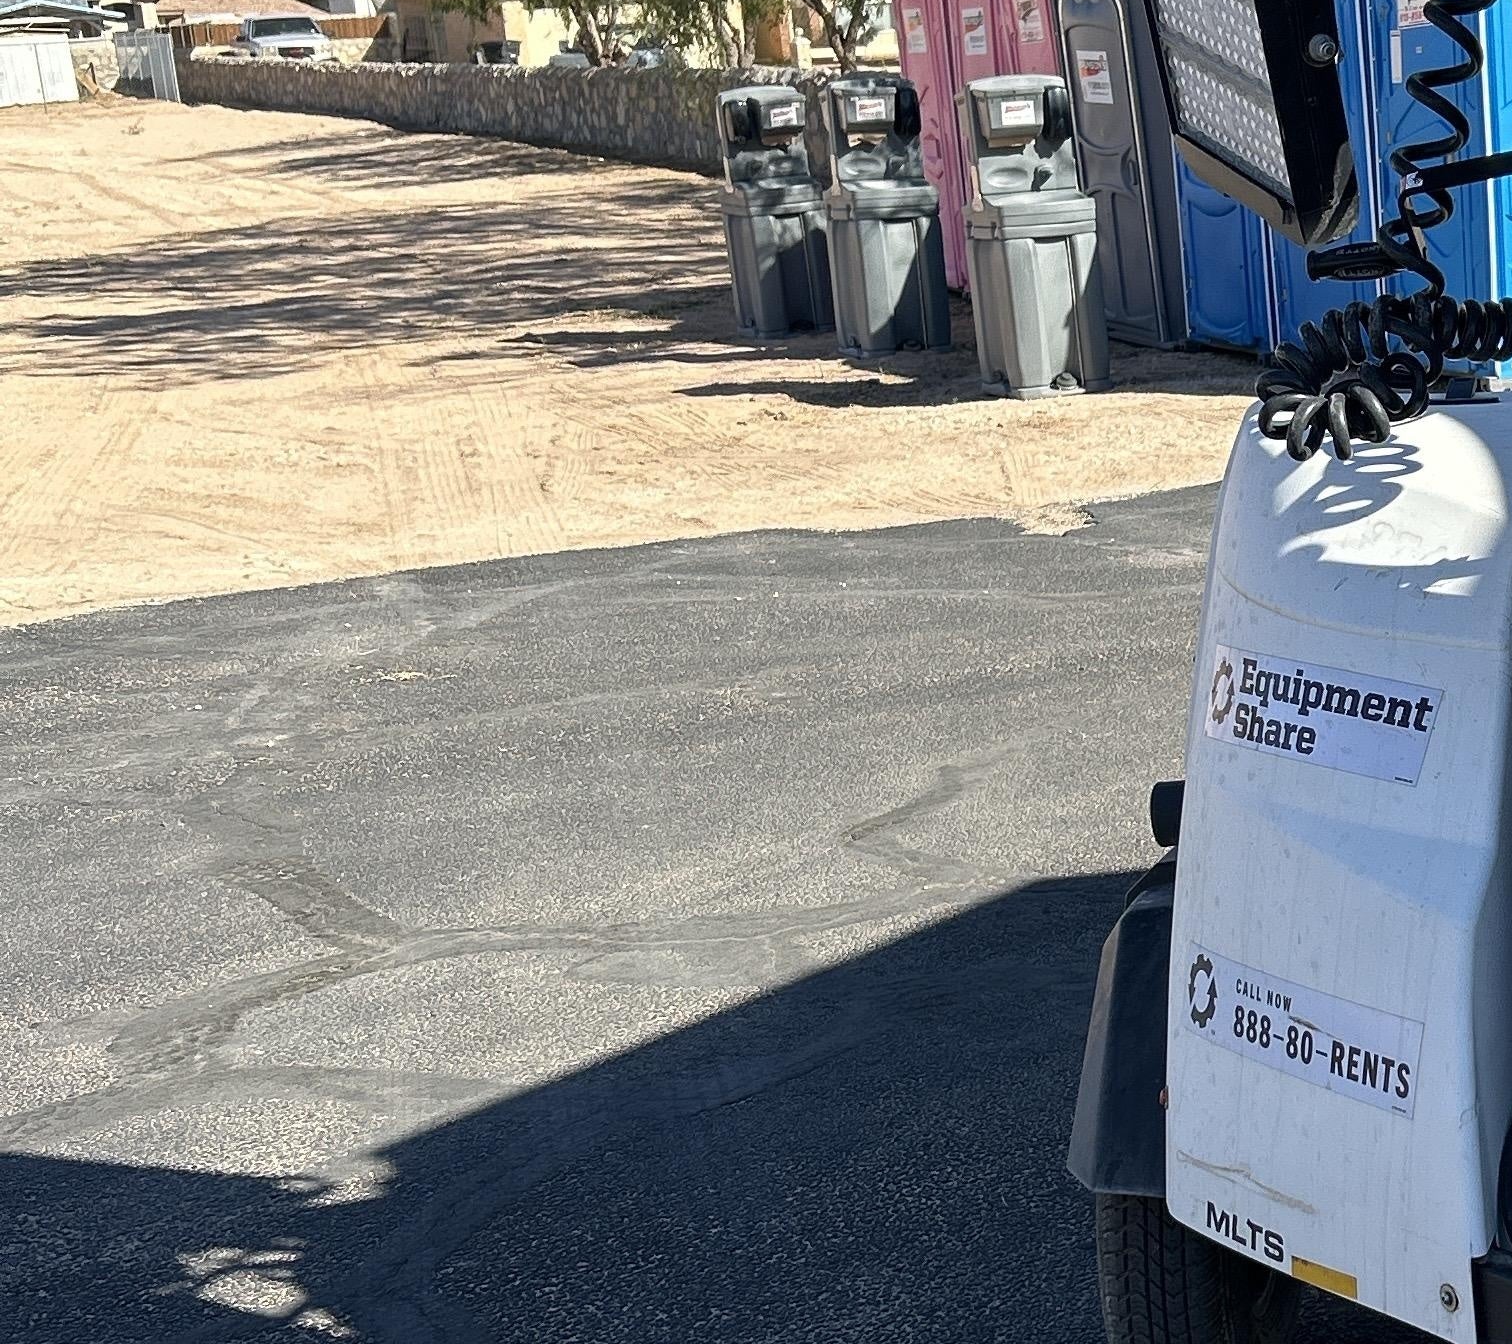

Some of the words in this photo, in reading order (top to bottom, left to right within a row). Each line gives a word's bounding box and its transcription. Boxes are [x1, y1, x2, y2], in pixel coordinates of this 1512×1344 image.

[1239, 657, 1434, 733] Equipment
[1233, 702, 1316, 756] Share
[1236, 977, 1262, 1003] CALL
[1267, 987, 1292, 1013] NOW
[1233, 1004, 1412, 1099] 888-80-RENTS
[1206, 1199, 1286, 1263] MLTS
